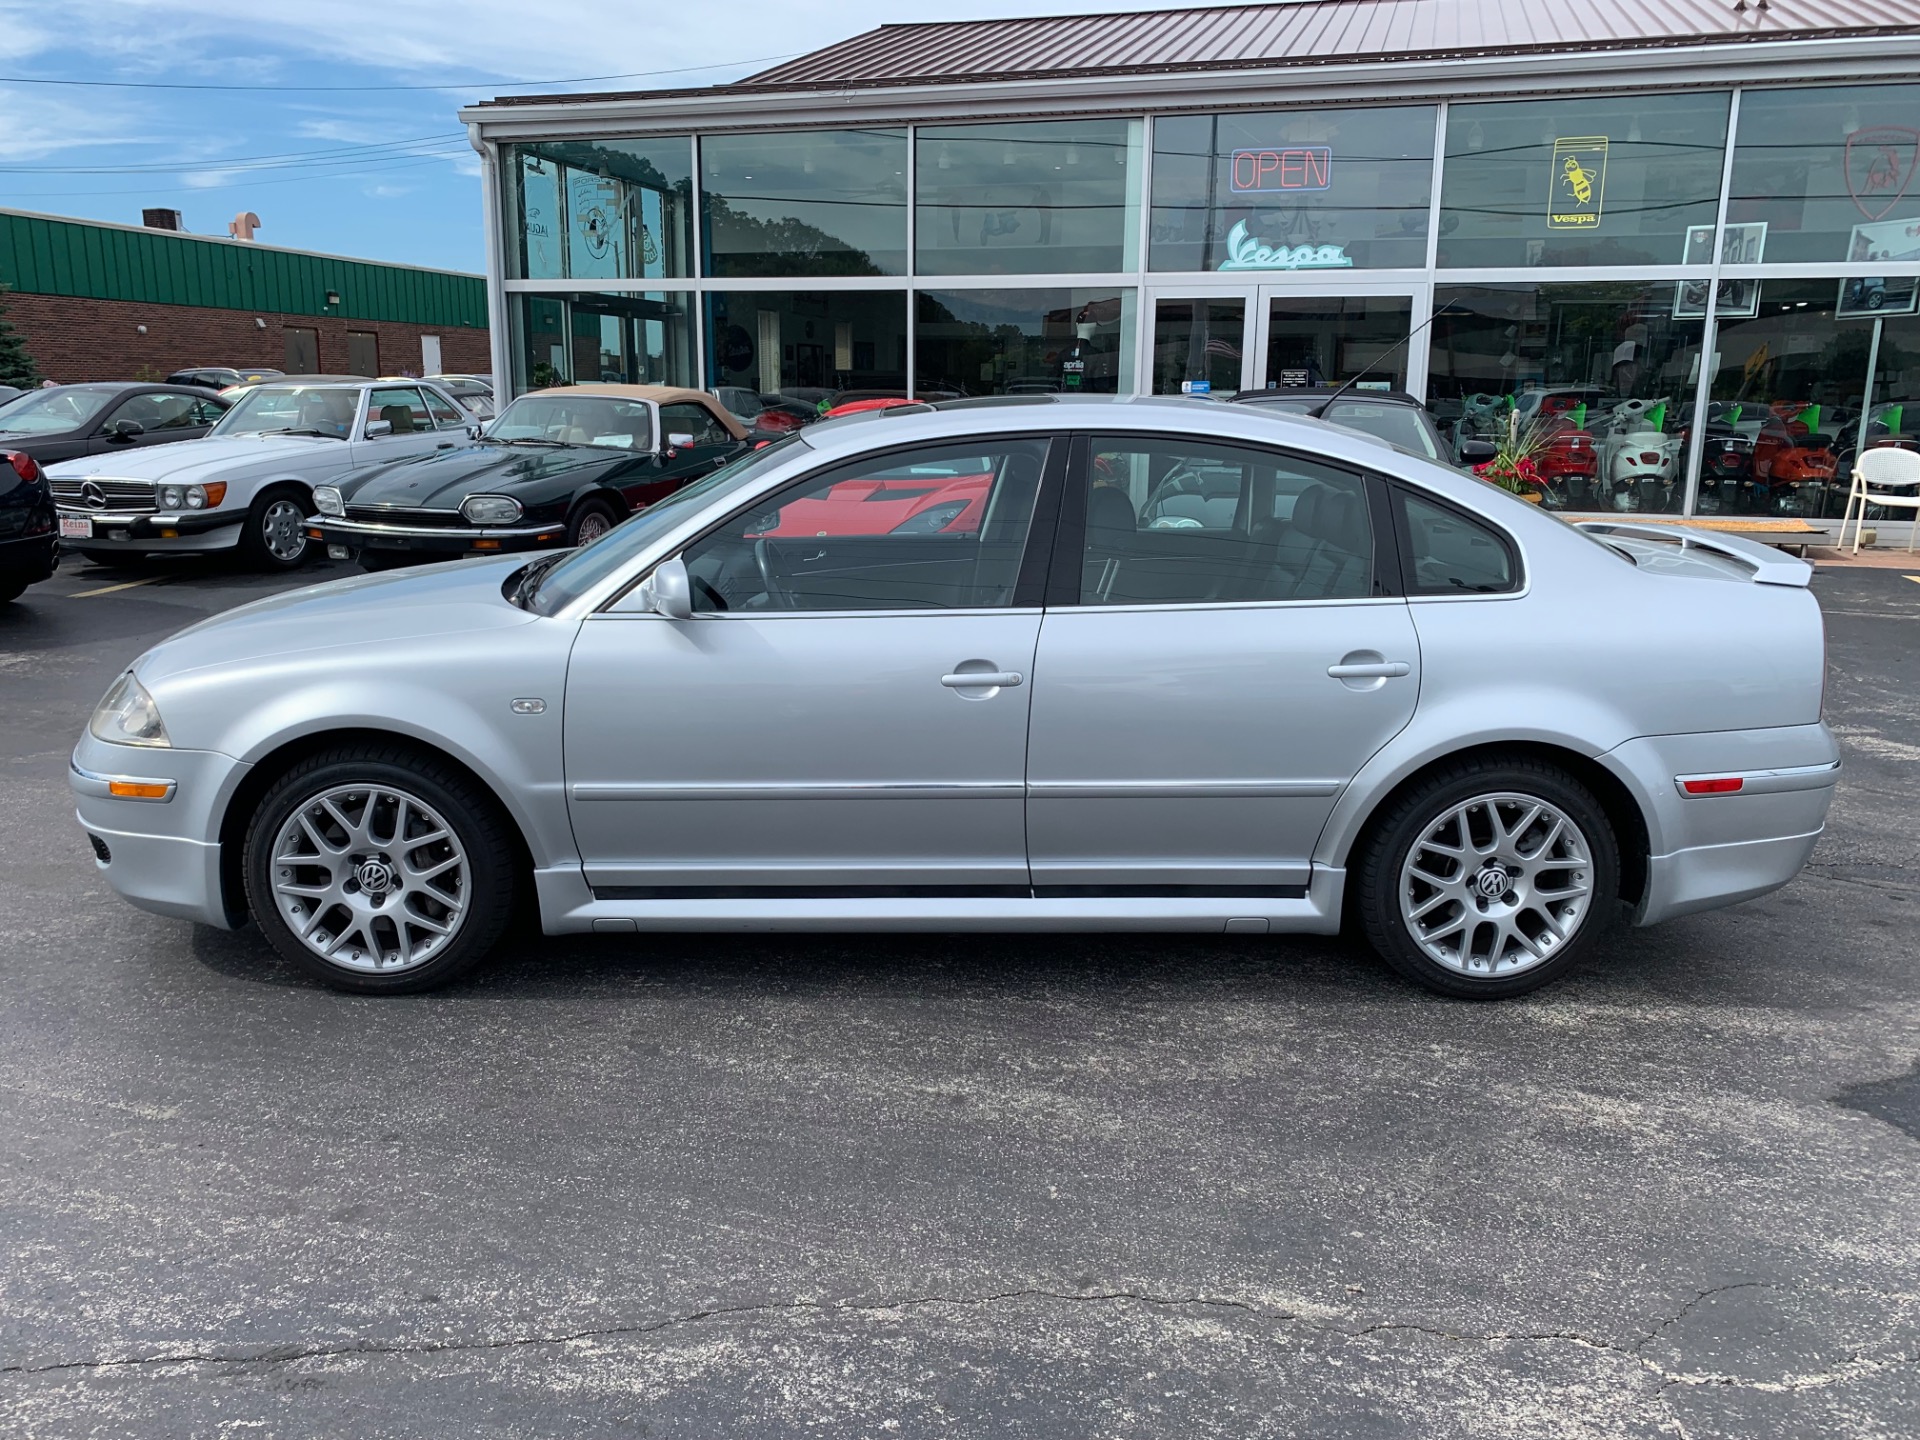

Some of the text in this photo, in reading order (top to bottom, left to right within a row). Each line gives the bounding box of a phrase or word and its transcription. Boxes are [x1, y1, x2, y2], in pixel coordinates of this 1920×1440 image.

[1235, 150, 1328, 188] OPEN
[1552, 214, 1596, 225] Vespa
[1217, 218, 1353, 271] Vespa
[1063, 360, 1084, 370] aprilia
[63, 519, 89, 529] Reina
